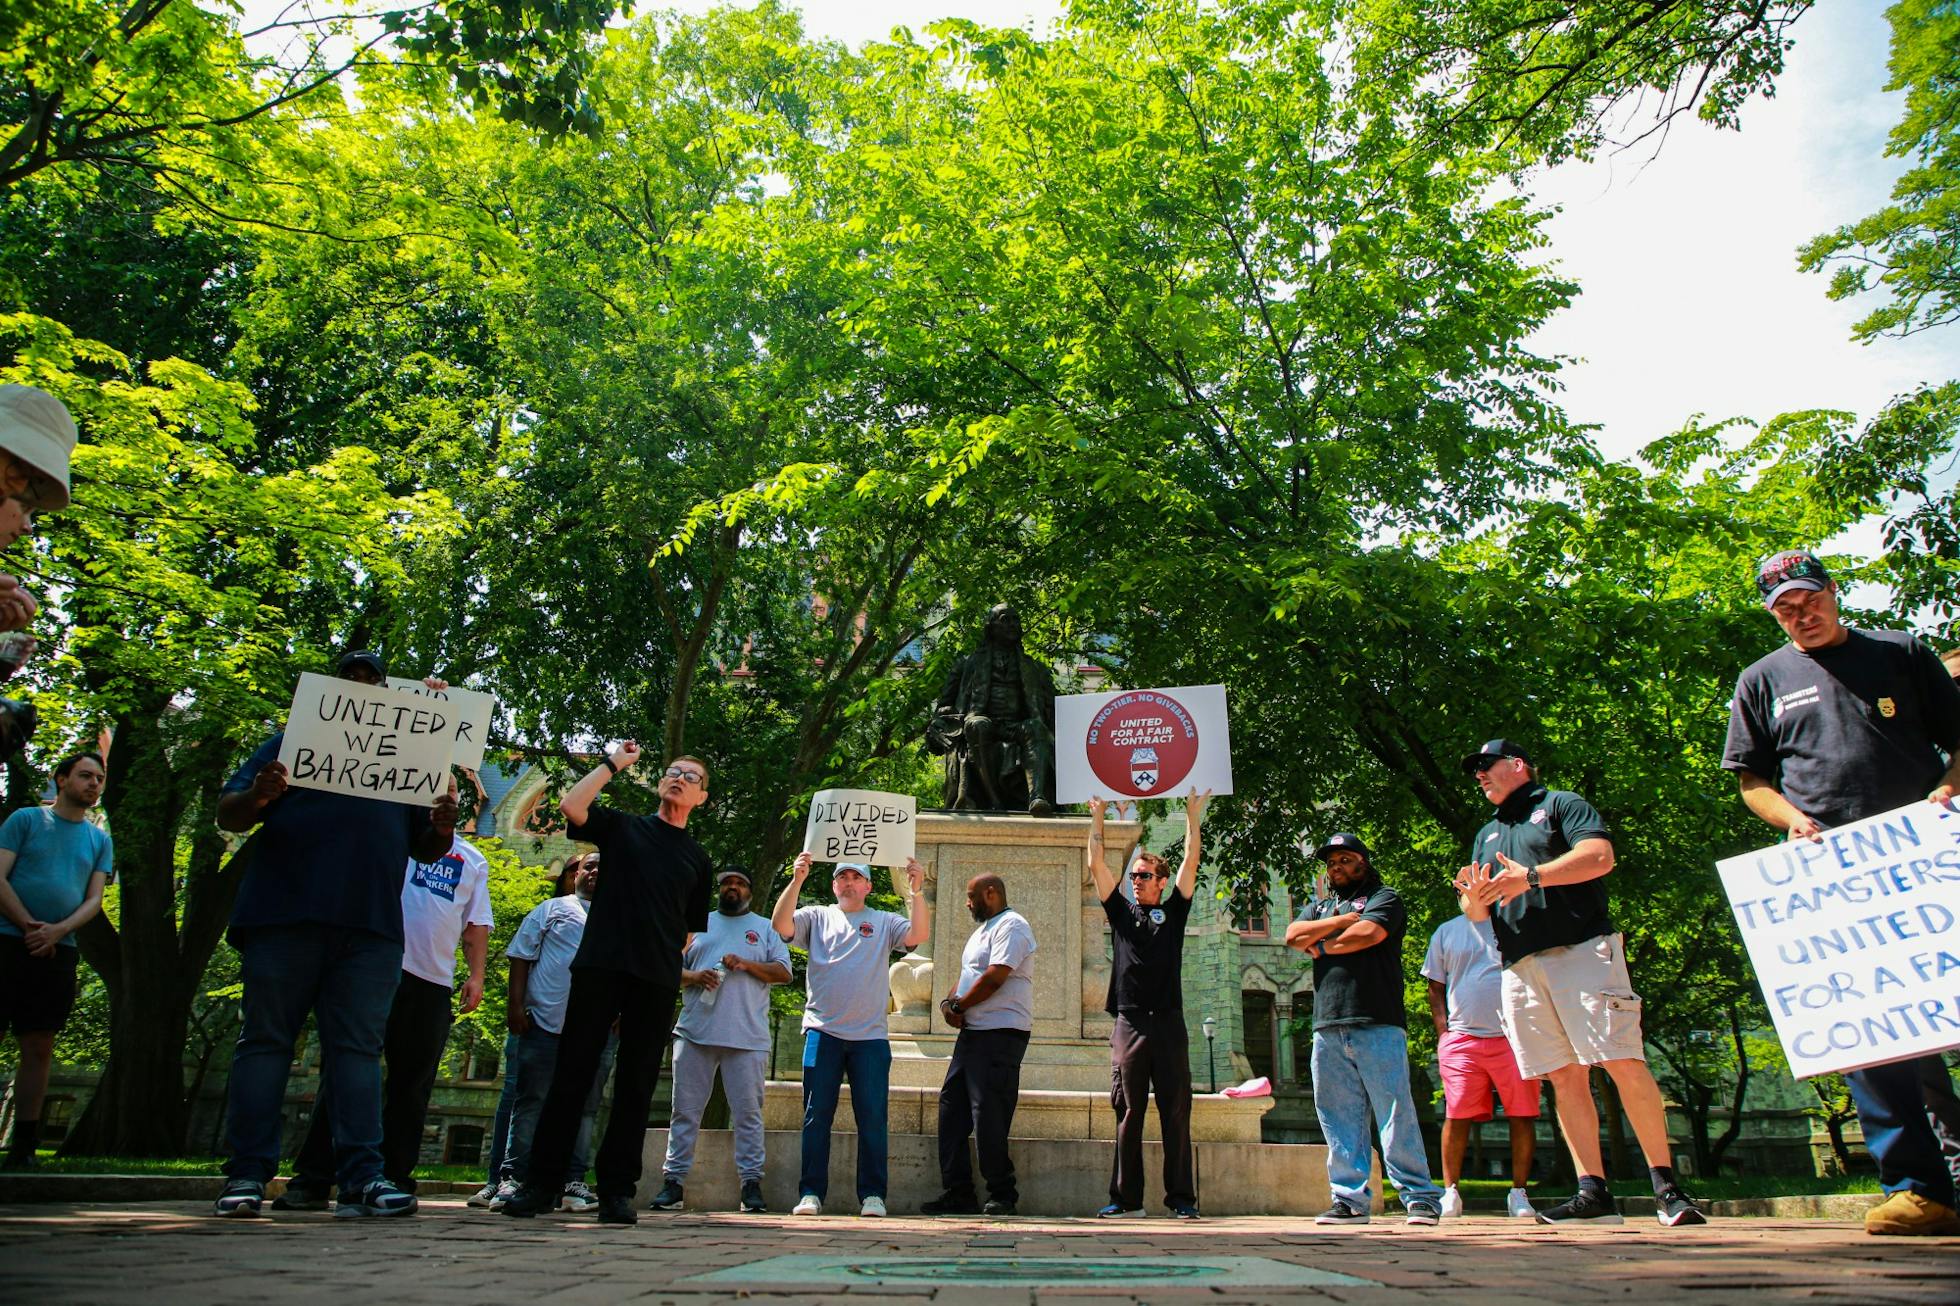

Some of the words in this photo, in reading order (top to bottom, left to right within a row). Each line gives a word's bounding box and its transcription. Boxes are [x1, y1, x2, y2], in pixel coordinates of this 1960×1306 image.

[319, 694, 446, 734] UNITED
[1089, 729, 1099, 744] NO
[1138, 694, 1154, 702] NO
[1156, 697, 1194, 738] GIVEBACKS
[1120, 717, 1163, 728] UNITED
[344, 730, 398, 757] WE
[1110, 729, 1135, 738] FOR
[1136, 728, 1144, 736] A
[1146, 726, 1173, 735] FAIR
[1113, 734, 1175, 747] CONTRACT
[292, 747, 441, 794] BARGAIN
[815, 802, 909, 824] DIVIDED
[842, 824, 877, 839] WE
[826, 837, 878, 862] BEG
[1756, 815, 1921, 886] UPENN
[416, 870, 453, 894] WRKERS
[419, 862, 454, 880] WAR
[1734, 850, 1960, 930] TEAMSTERS
[1778, 903, 1955, 966] UNITED
[1774, 971, 1866, 1018] FOR
[1874, 966, 1906, 994] A
